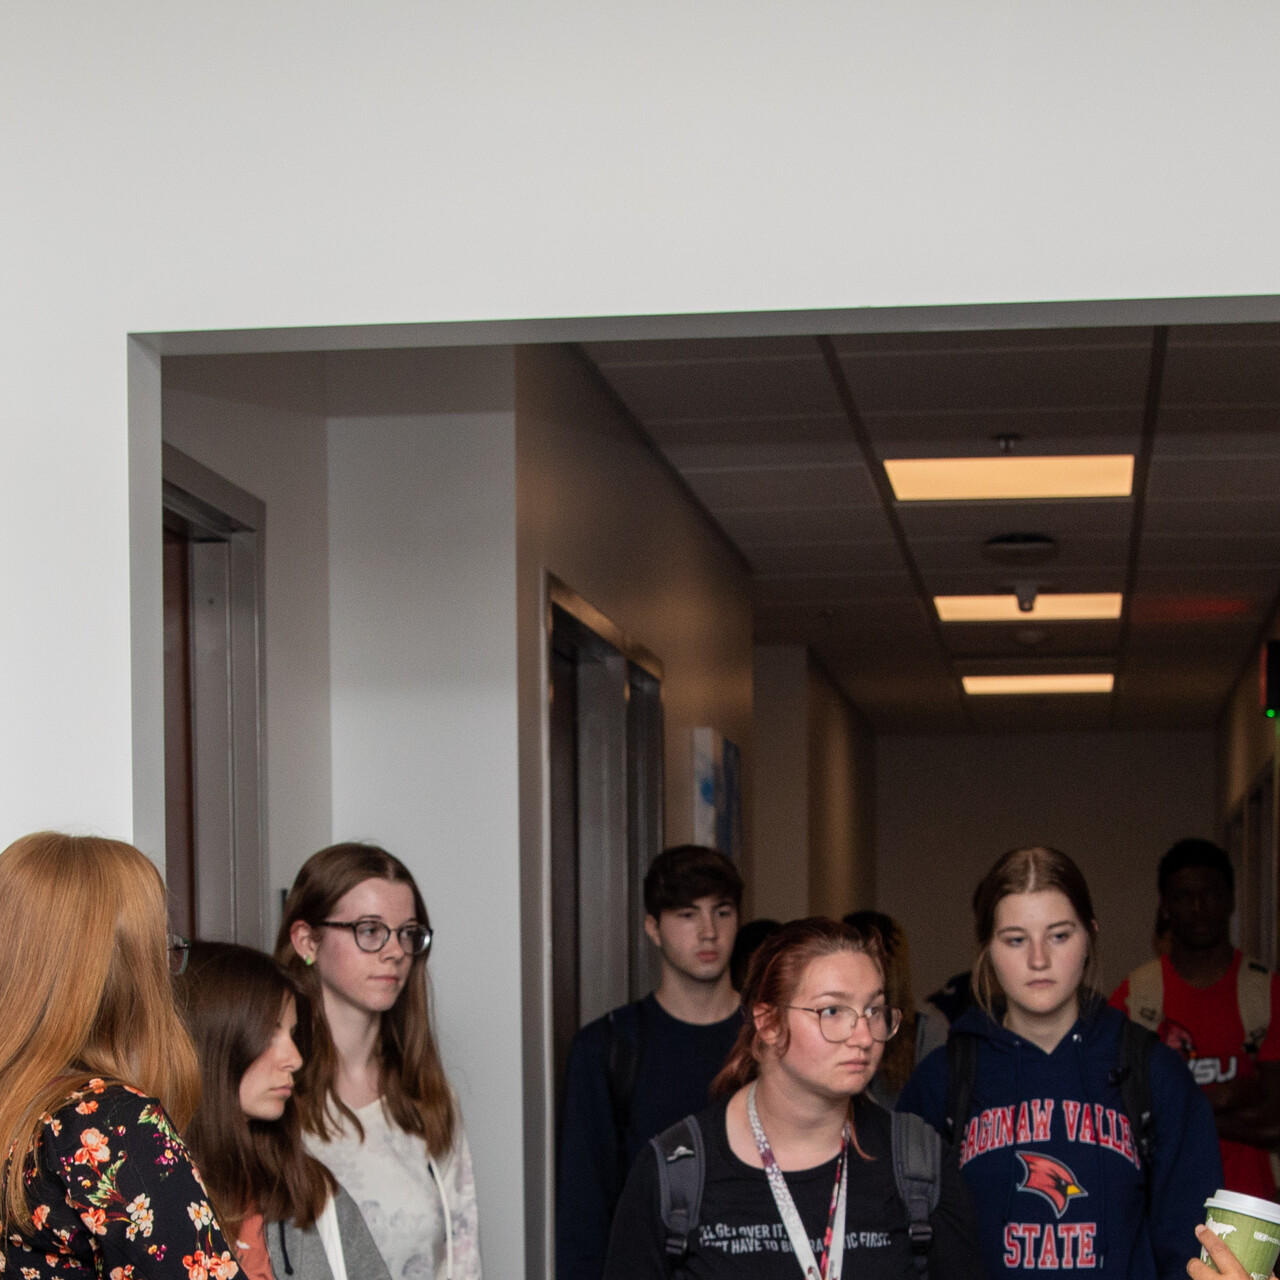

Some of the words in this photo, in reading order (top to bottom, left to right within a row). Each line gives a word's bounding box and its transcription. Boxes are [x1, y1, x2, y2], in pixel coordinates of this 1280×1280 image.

[1063, 1100, 1140, 1170] VALLE
[731, 1237, 762, 1254] HAVE
[738, 1224, 770, 1239] OVER
[1004, 1222, 1096, 1269] STATE
